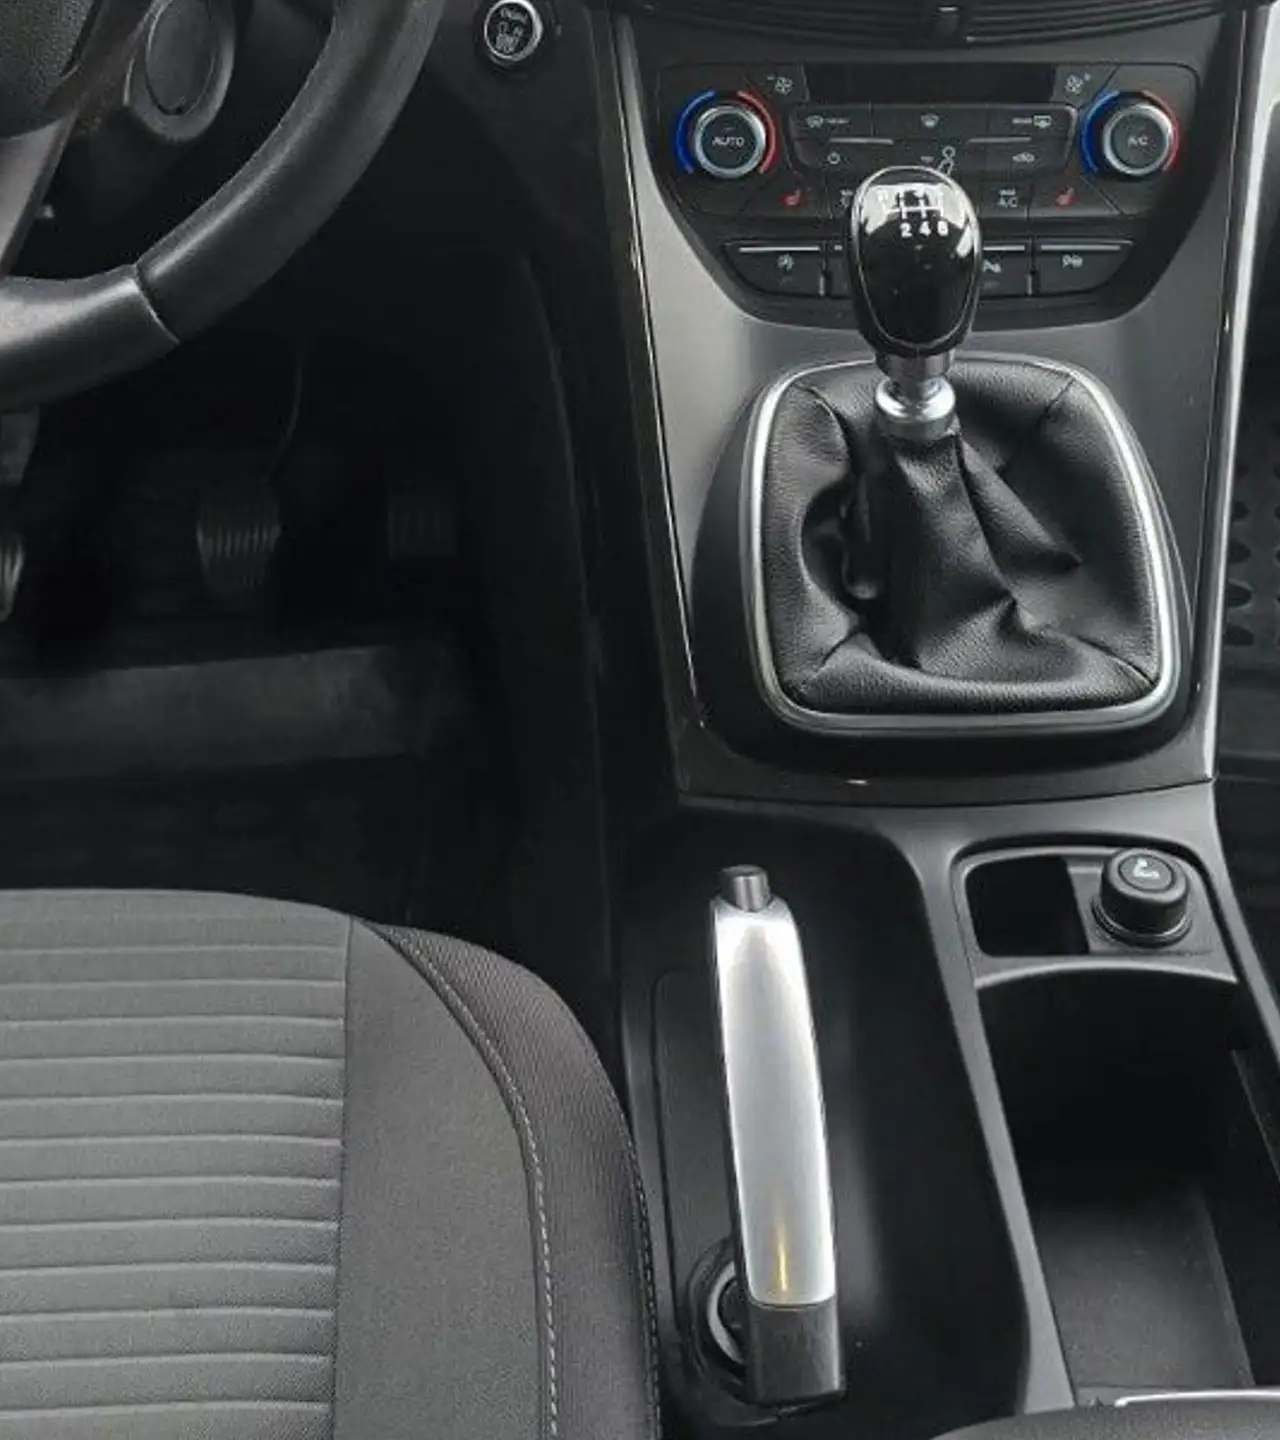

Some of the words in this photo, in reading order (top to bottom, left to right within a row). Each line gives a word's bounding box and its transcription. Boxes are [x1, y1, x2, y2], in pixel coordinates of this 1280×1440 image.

[711, 136, 745, 147] AUTO
[901, 222, 913, 238] 2
[920, 221, 932, 236] 4
